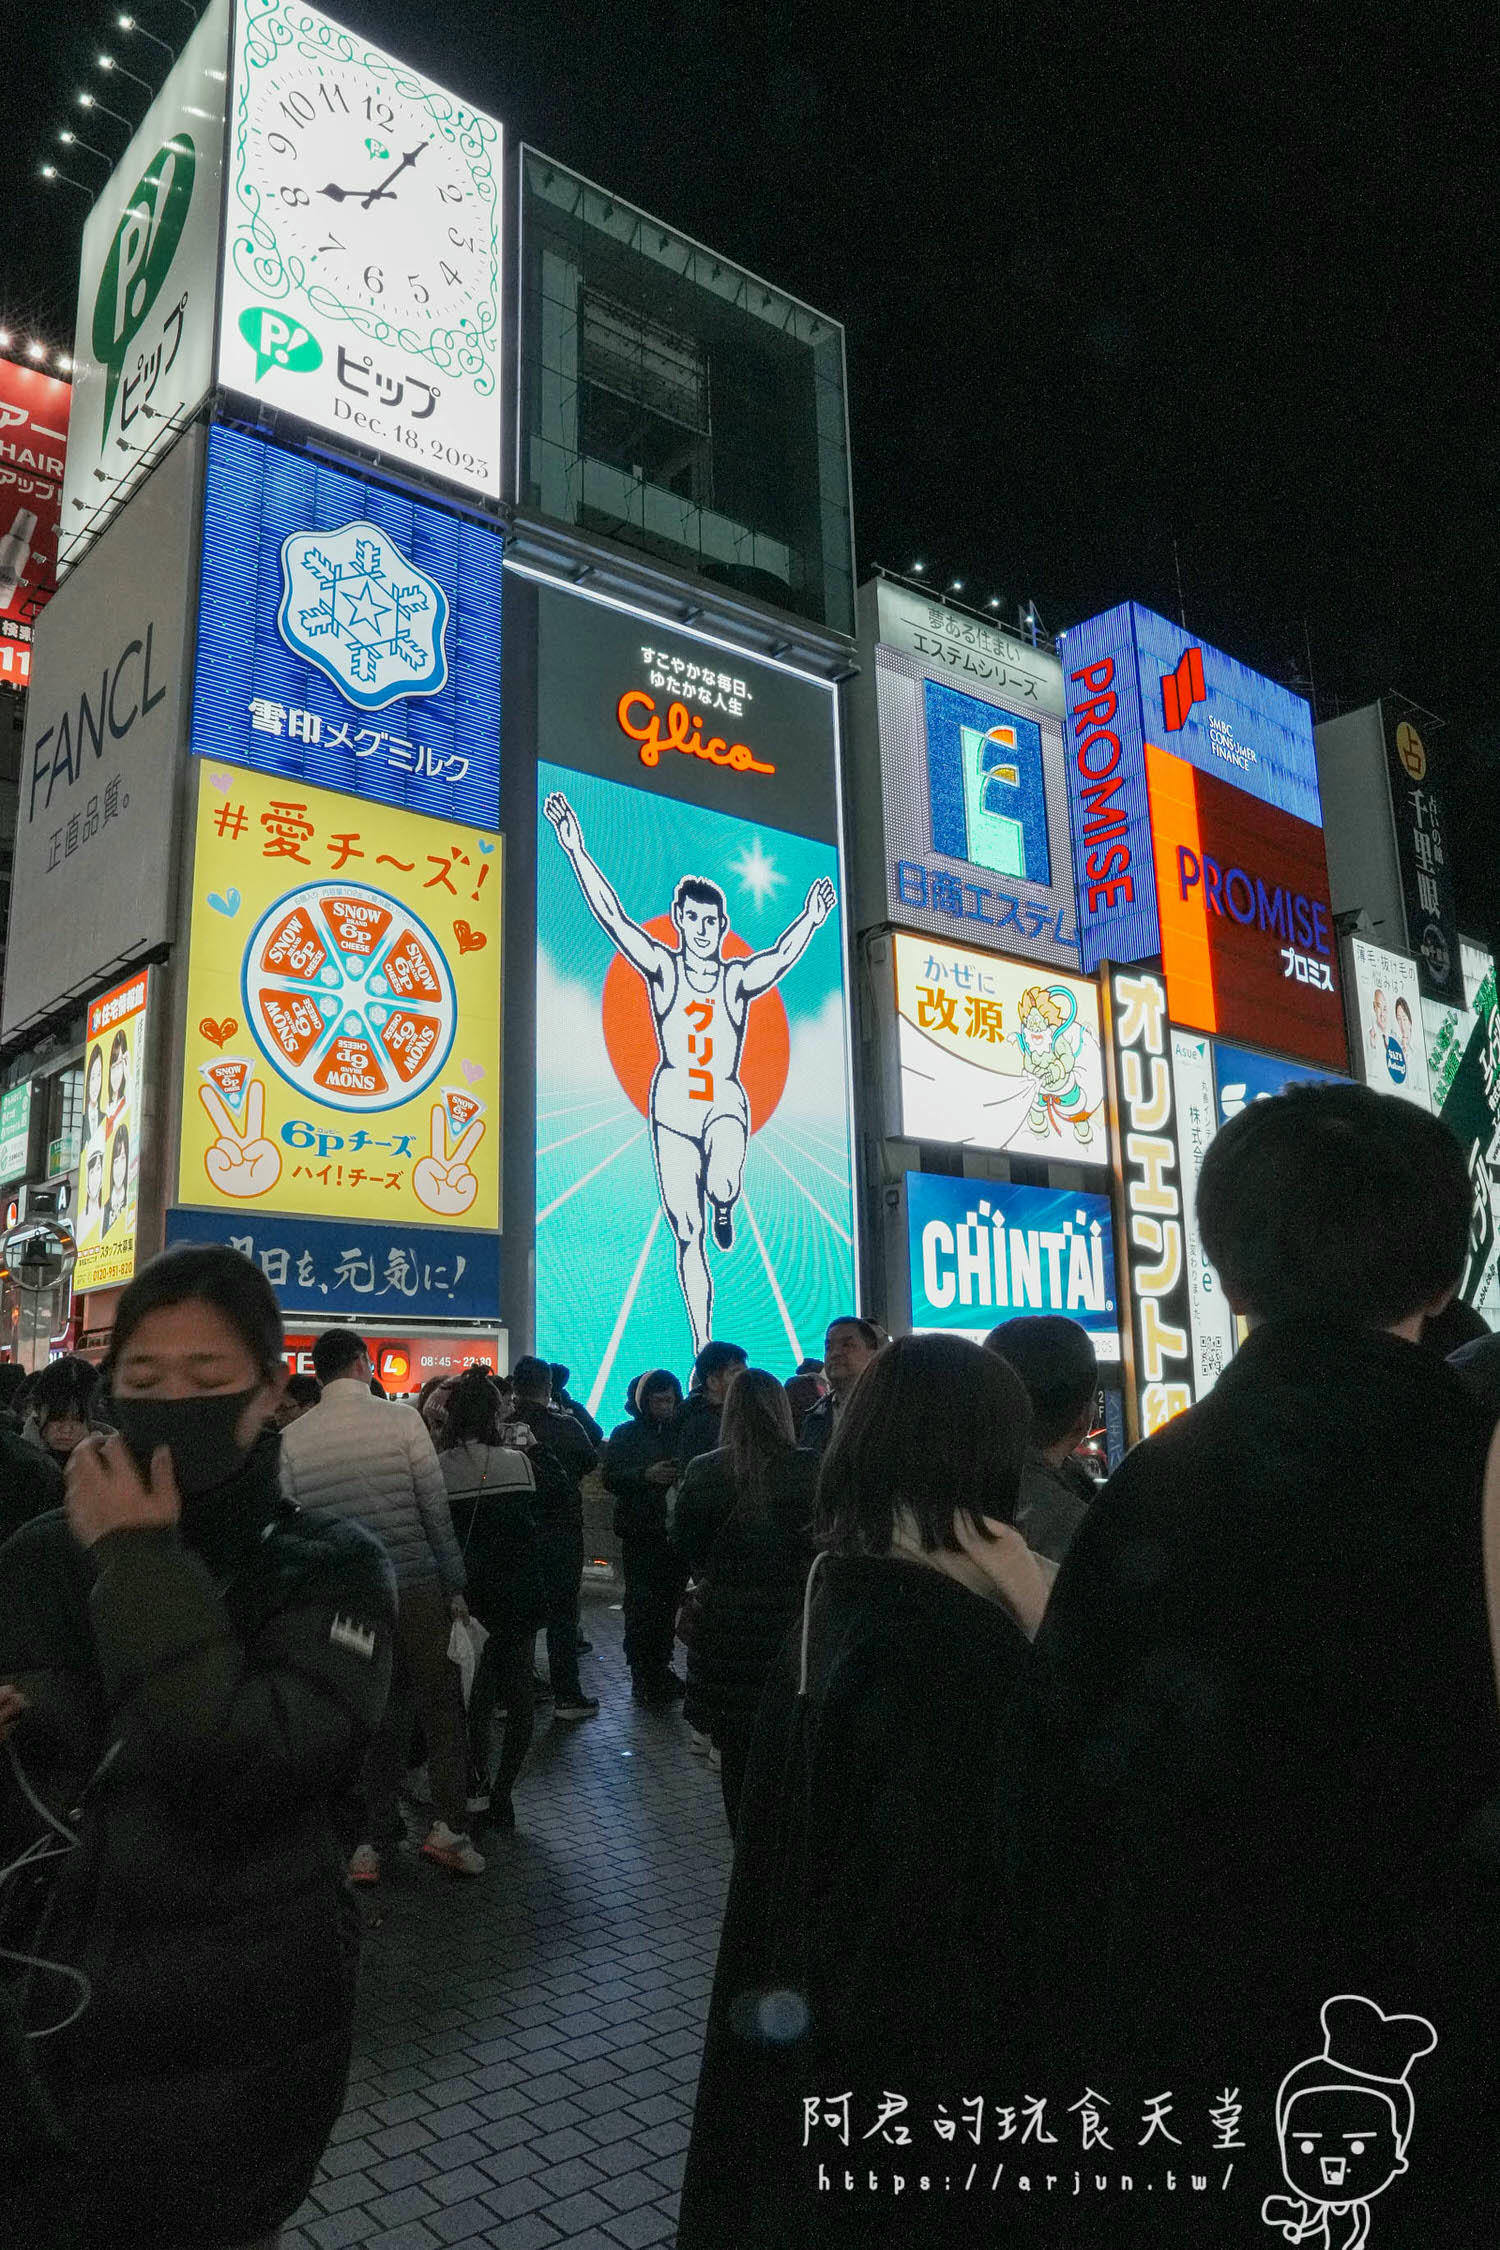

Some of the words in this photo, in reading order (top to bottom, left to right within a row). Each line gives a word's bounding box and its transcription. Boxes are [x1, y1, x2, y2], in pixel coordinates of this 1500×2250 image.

[280, 91, 316, 129] 10
[318, 83, 351, 115] 11
[361, 95, 396, 134] 12
[268, 132, 299, 160] 9
[279, 186, 311, 208] 8
[437, 183, 463, 204] 2
[317, 232, 347, 254] 7
[447, 226, 474, 253] 3
[363, 264, 384, 295] 6
[407, 274, 430, 304] 5
[440, 259, 462, 288] 4
[120, 290, 189, 432] ピップ
[338, 345, 441, 419] ピップ
[333, 398, 388, 439] Dec.
[395, 424, 424, 456] 18,
[431, 442, 489, 479] 2023
[928, 607, 1020, 661] 夢ある住まい
[641, 646, 754, 700] すこやかな毎日、
[914, 631, 1038, 700] エステムシリーズ
[650, 670, 744, 717] ゆたかな人生
[29, 622, 166, 824] FANCL
[248, 696, 469, 782] 雪印メグミルク
[618, 690, 776, 774] Glico
[1208, 715, 1233, 737] SMBC
[1210, 729, 1257, 763] CONSUMER
[1211, 742, 1249, 771] FINANCE
[1071, 657, 1134, 914] PROMISE
[47, 773, 129, 873] 正直品質。
[333, 902, 381, 924] SNOW
[898, 860, 1079, 948] 日商エステム
[1176, 844, 1330, 955] PROMISE
[268, 915, 303, 964] SNOW
[341, 940, 370, 953] CHEESE
[303, 950, 325, 977] CHEESE
[406, 943, 437, 991] SNOW
[923, 954, 996, 996] かぜに
[1280, 947, 1334, 992] プロミス
[264, 1001, 299, 1053] SNOW
[916, 985, 1005, 1044] 改源
[337, 1039, 368, 1051] CHEESE
[404, 1025, 434, 1074] SNOW
[684, 998, 716, 1102] グリコ
[1175, 1043, 1197, 1060] Asue
[325, 1070, 376, 1090] SNOW
